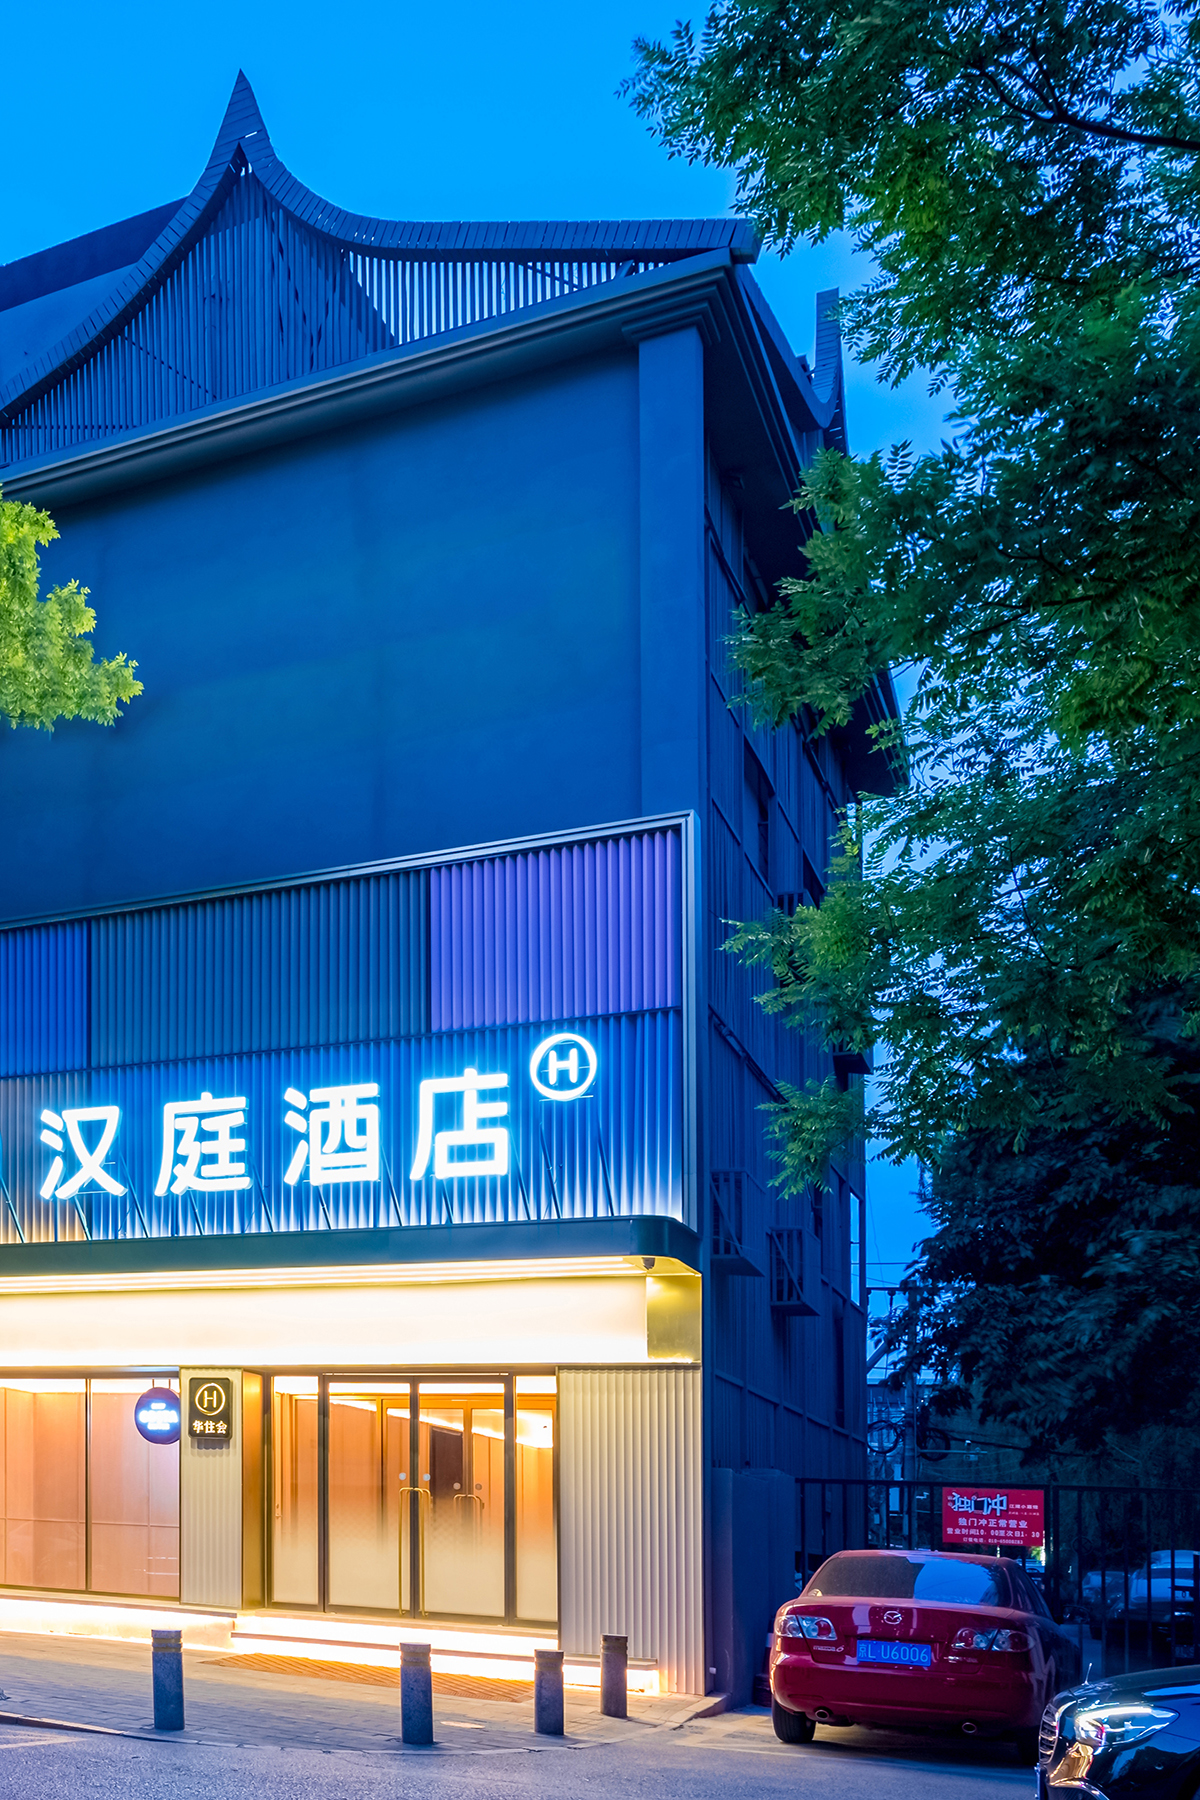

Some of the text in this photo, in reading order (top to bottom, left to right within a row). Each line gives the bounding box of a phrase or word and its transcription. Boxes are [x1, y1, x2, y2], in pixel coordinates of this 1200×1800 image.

[40, 1068, 509, 1200] 汉庭酒店
[192, 1420, 228, 1434] 华住会
[951, 1492, 1007, 1516] 独门冲
[958, 1517, 1028, 1529] 独门冲正常营业
